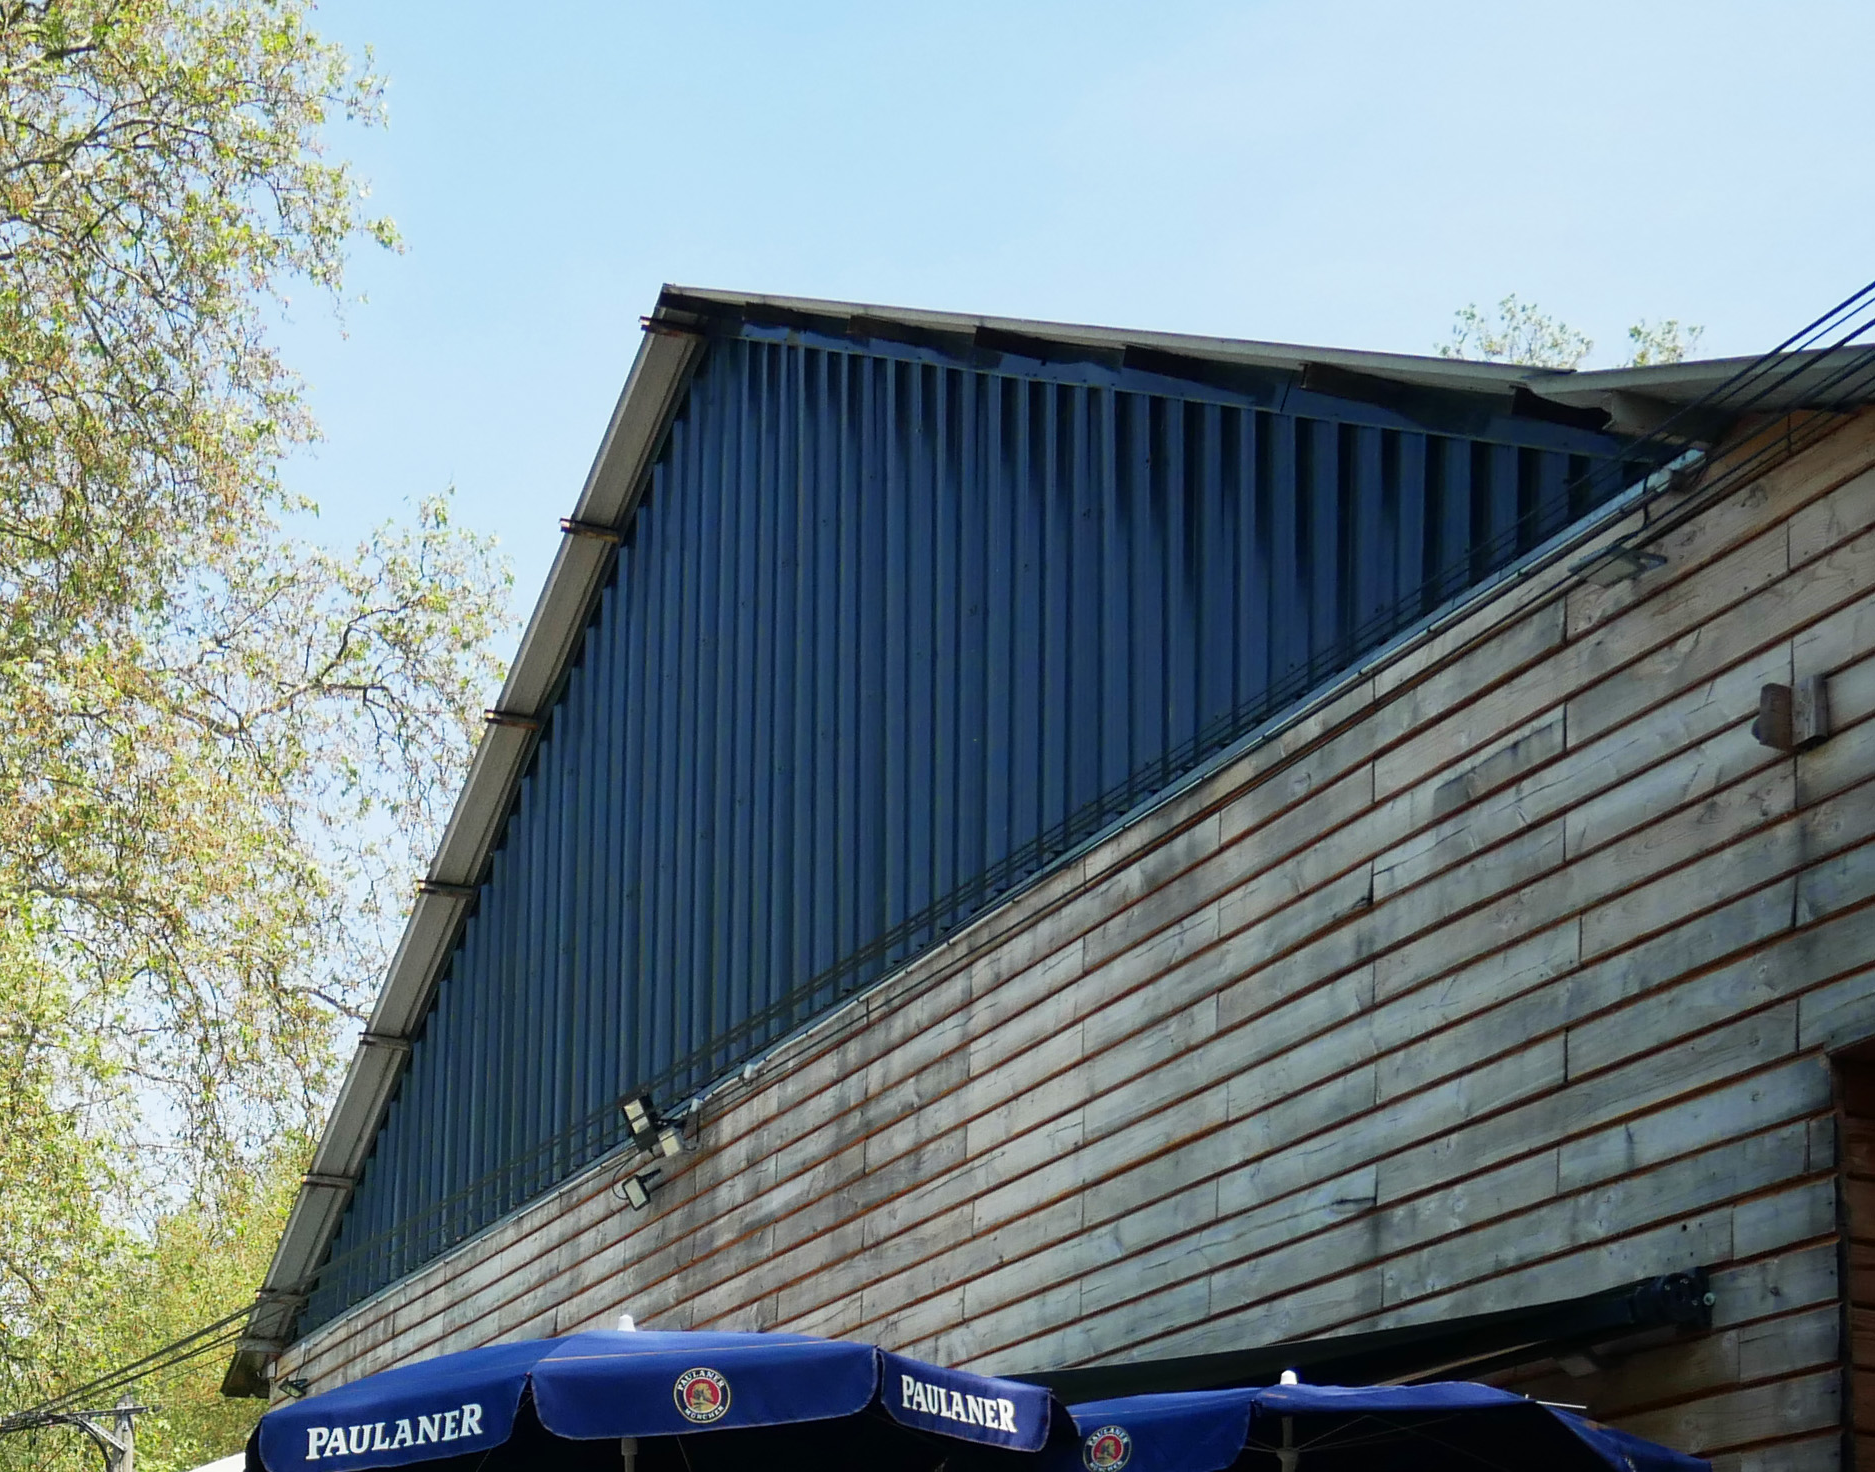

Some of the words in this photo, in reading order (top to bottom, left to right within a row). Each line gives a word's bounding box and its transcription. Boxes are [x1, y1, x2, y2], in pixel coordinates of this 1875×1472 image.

[677, 1370, 725, 1391] PAULANER
[901, 1374, 1018, 1433] PAULANER
[305, 1403, 483, 1460] PAULANER
